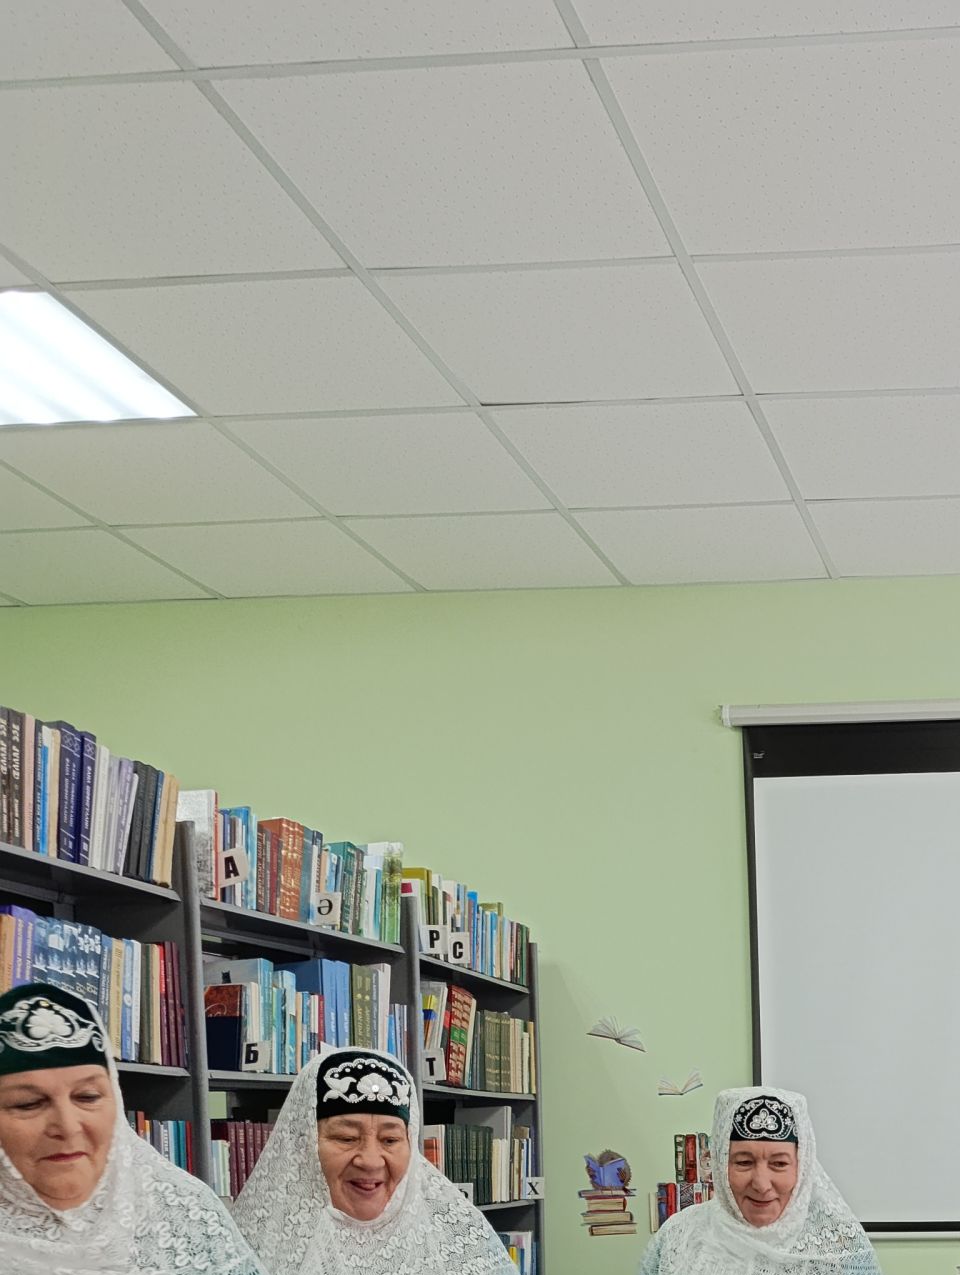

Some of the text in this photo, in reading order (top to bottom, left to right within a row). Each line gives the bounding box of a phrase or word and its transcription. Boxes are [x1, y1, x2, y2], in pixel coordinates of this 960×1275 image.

[224, 855, 240, 880] А
[429, 930, 440, 948] Р
[452, 941, 464, 959] С
[245, 1043, 258, 1064] Б
[425, 1057, 436, 1076] Т
[527, 1182, 540, 1196] Х
